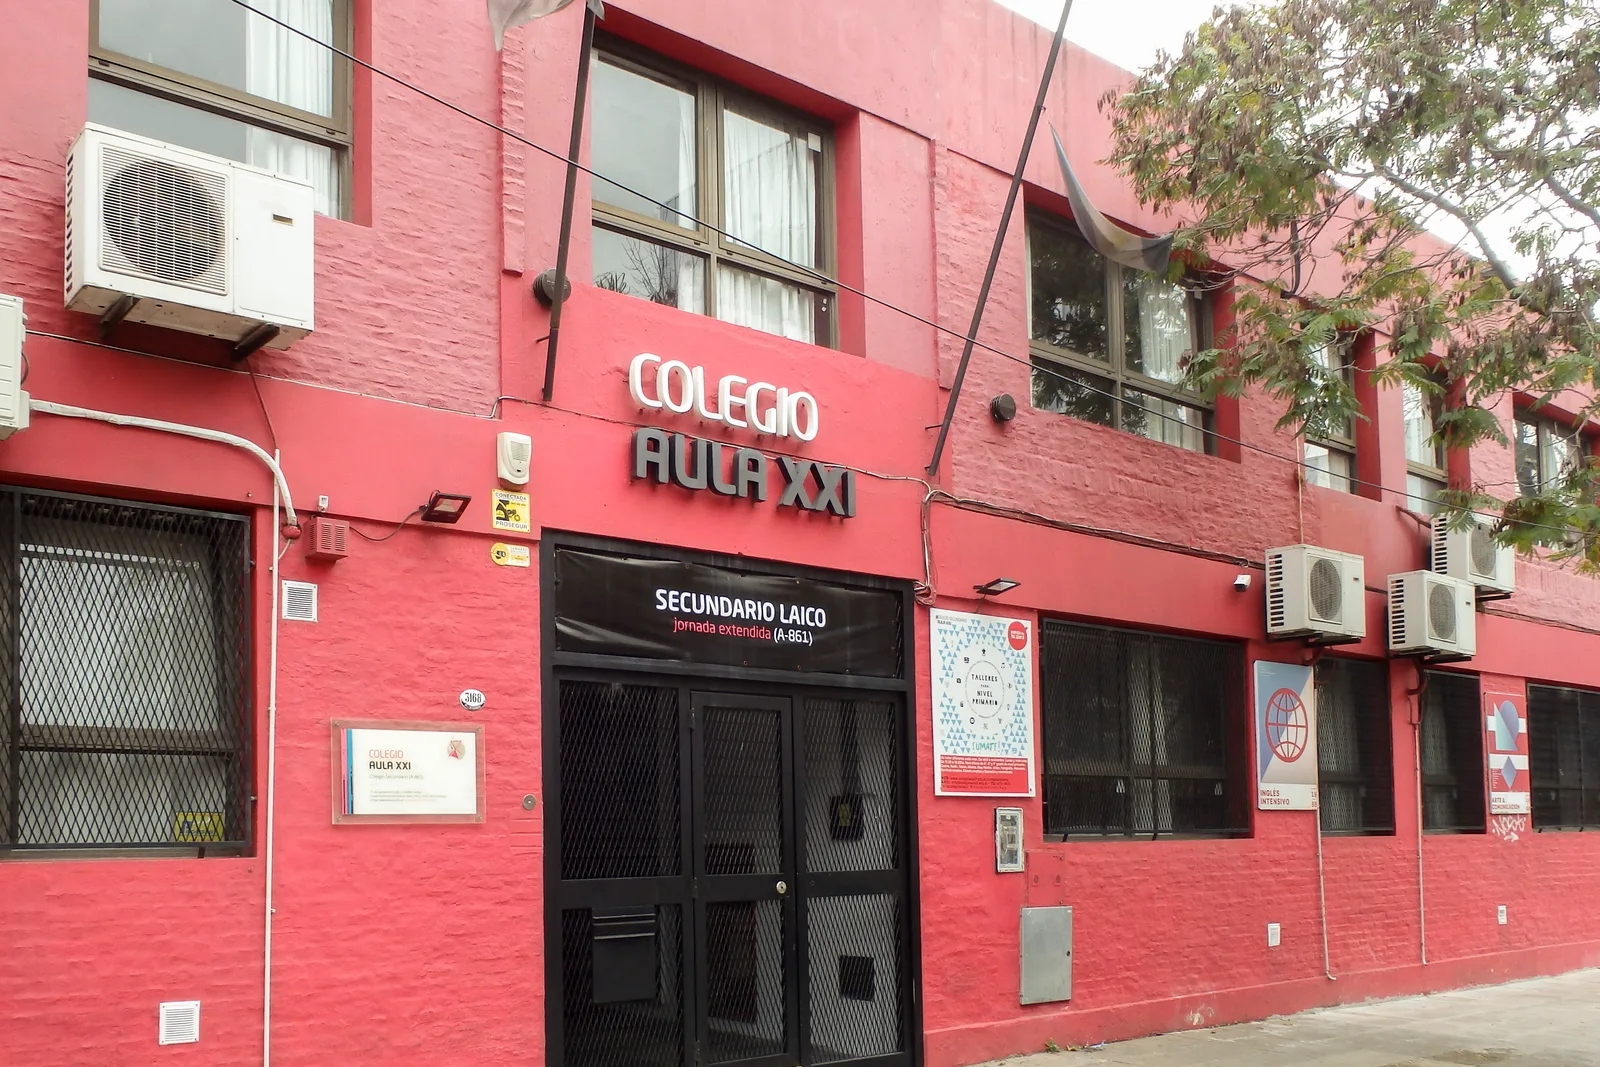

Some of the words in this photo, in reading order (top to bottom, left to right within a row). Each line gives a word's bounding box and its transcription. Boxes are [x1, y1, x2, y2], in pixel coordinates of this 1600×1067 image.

[629, 353, 819, 441] COLEGIO
[631, 427, 768, 502] AULA
[776, 456, 856, 518] XXI
[495, 492, 527, 501] CONECTADA
[496, 521, 528, 530] PROSEGUR
[655, 588, 775, 622] SECUNDARIO
[779, 603, 827, 628] LAICO
[673, 616, 716, 634] jornada
[718, 623, 772, 640] extendida
[773, 627, 813, 647] (A-861)
[971, 673, 998, 682] TALLERES
[464, 692, 482, 703] 3168
[972, 698, 998, 706] PRIMARIO
[368, 749, 404, 759] COLEGIO
[369, 761, 393, 770] AULA
[395, 761, 411, 770] XXI
[1260, 788, 1280, 797] INGLÉS
